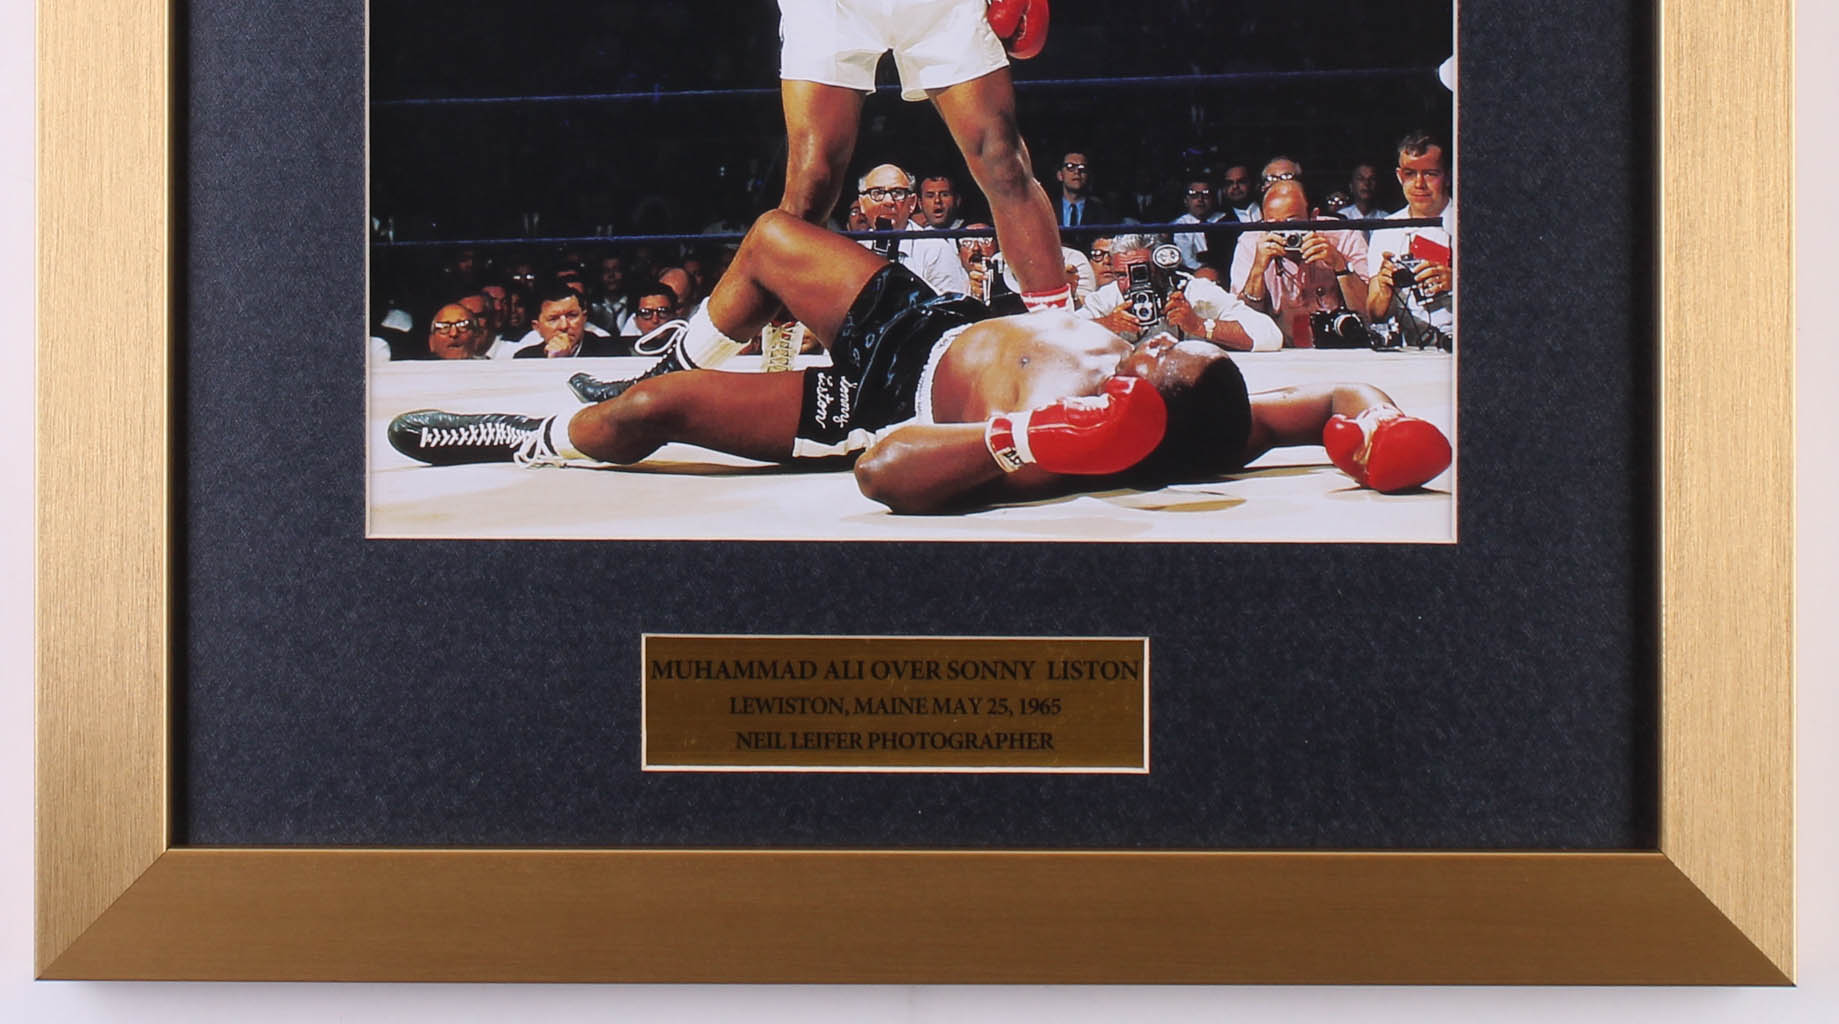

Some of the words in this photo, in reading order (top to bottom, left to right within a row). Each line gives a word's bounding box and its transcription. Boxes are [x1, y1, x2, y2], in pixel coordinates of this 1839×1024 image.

[815, 372, 834, 429] Liston
[832, 376, 858, 428] Sonny
[651, 660, 817, 680] MUHAMMAD
[823, 660, 865, 680] ALI
[870, 660, 940, 680] OVER
[946, 660, 1035, 680] SONNY
[1047, 660, 1139, 680] LISTON
[729, 696, 850, 716] LEWISTON,
[853, 696, 929, 715] MAINE
[932, 697, 983, 715] MAY
[986, 697, 1013, 717] 25,
[1019, 697, 1062, 716] 1965
[735, 731, 787, 750] NEIL
[790, 731, 863, 750] LEIFER
[867, 731, 1055, 750] PHOTOGRAPHER
